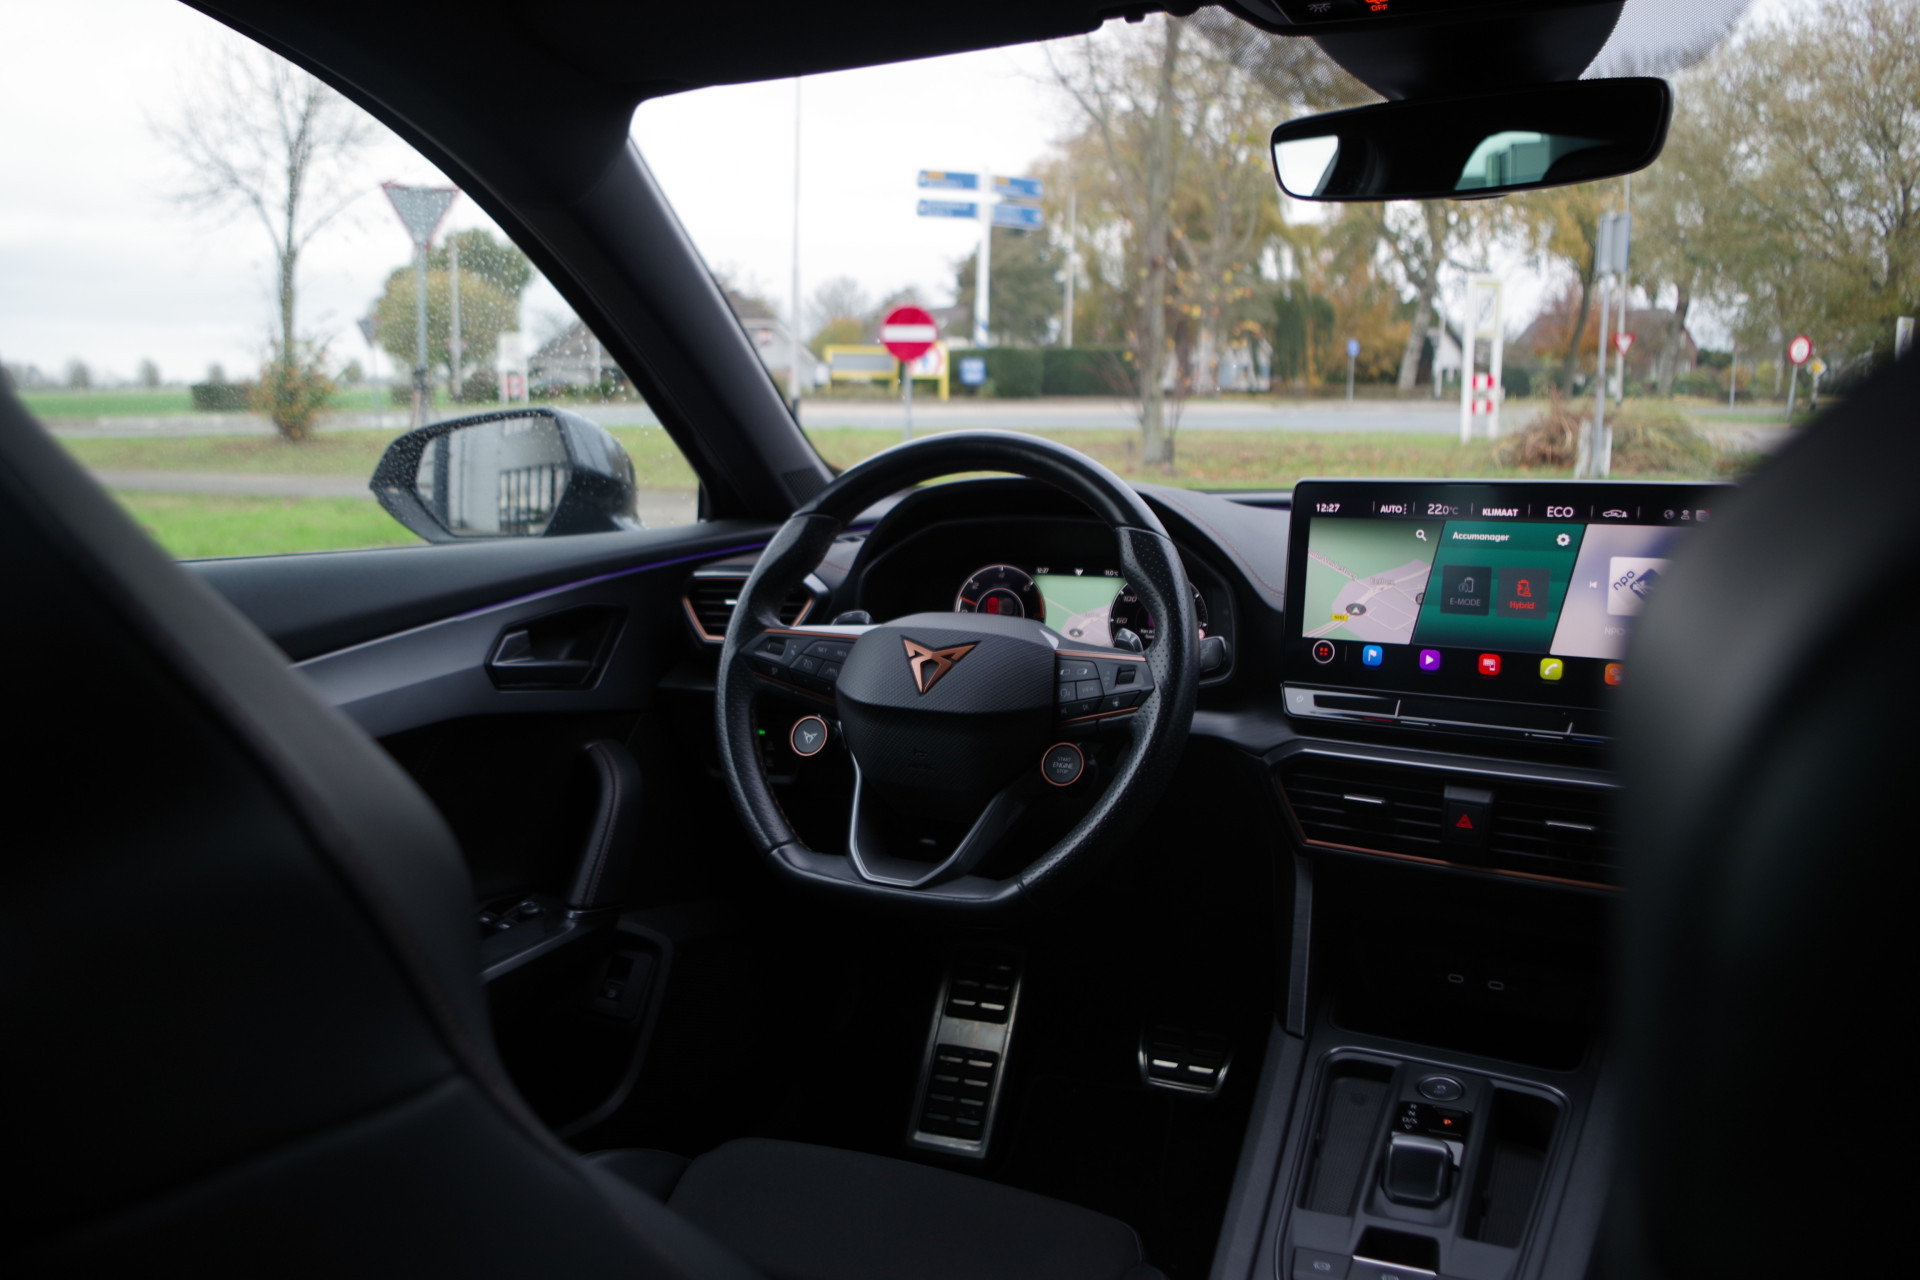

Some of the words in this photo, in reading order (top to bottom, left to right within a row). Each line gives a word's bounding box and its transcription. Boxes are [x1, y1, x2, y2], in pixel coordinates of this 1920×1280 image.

[1370, 4, 1389, 12] OFF
[1315, 503, 1341, 513] 12:27
[1380, 504, 1403, 514] AUTO
[1482, 508, 1519, 517] KLIMAAT
[1546, 506, 1574, 518] ECO
[1452, 531, 1510, 542] Accumanager
[1613, 570, 1635, 591] npo
[1449, 597, 1481, 606] E-MODE
[1509, 601, 1536, 610] Hybrid
